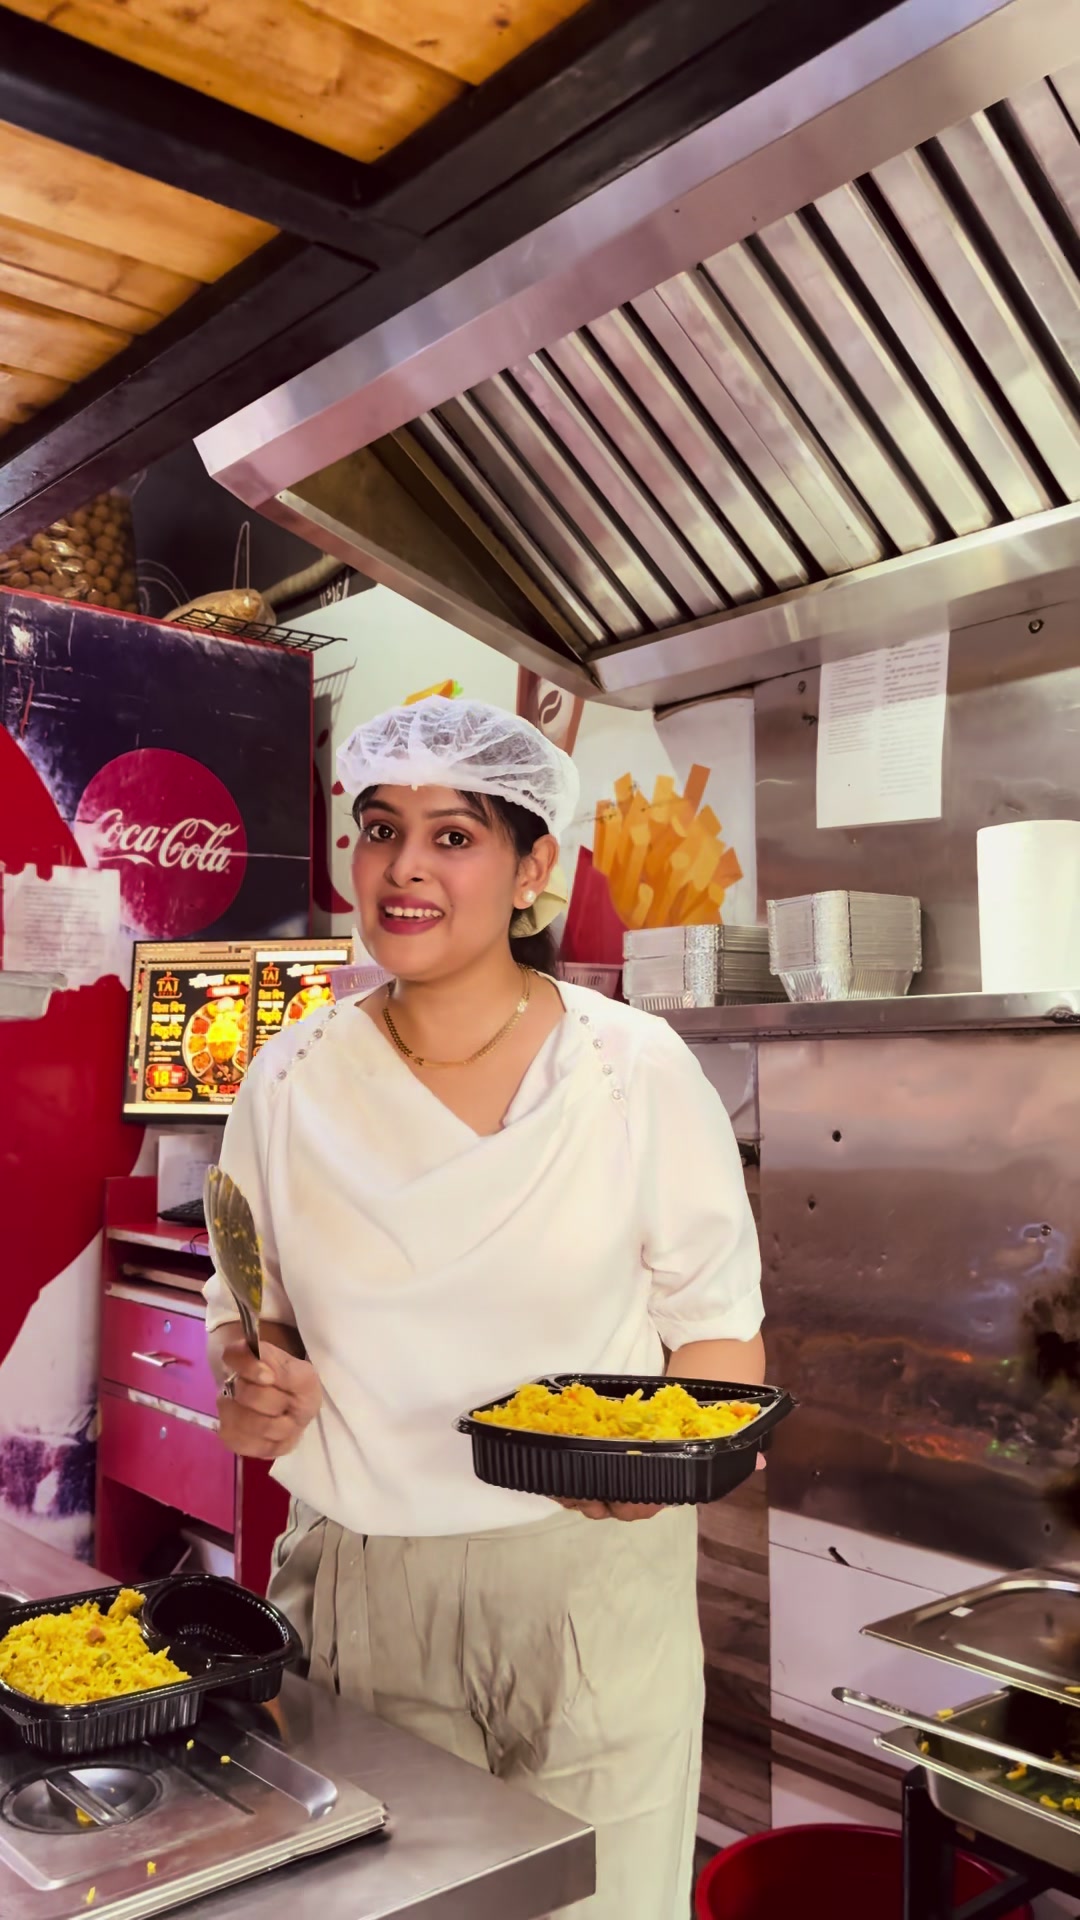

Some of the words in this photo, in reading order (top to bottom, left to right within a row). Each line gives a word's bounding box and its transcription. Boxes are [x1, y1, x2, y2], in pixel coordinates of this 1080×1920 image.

[96, 808, 240, 873] Coca-Cola
[262, 970, 279, 982] TAJ
[156, 980, 179, 992] TAJ
[195, 1084, 218, 1094] TAJ
